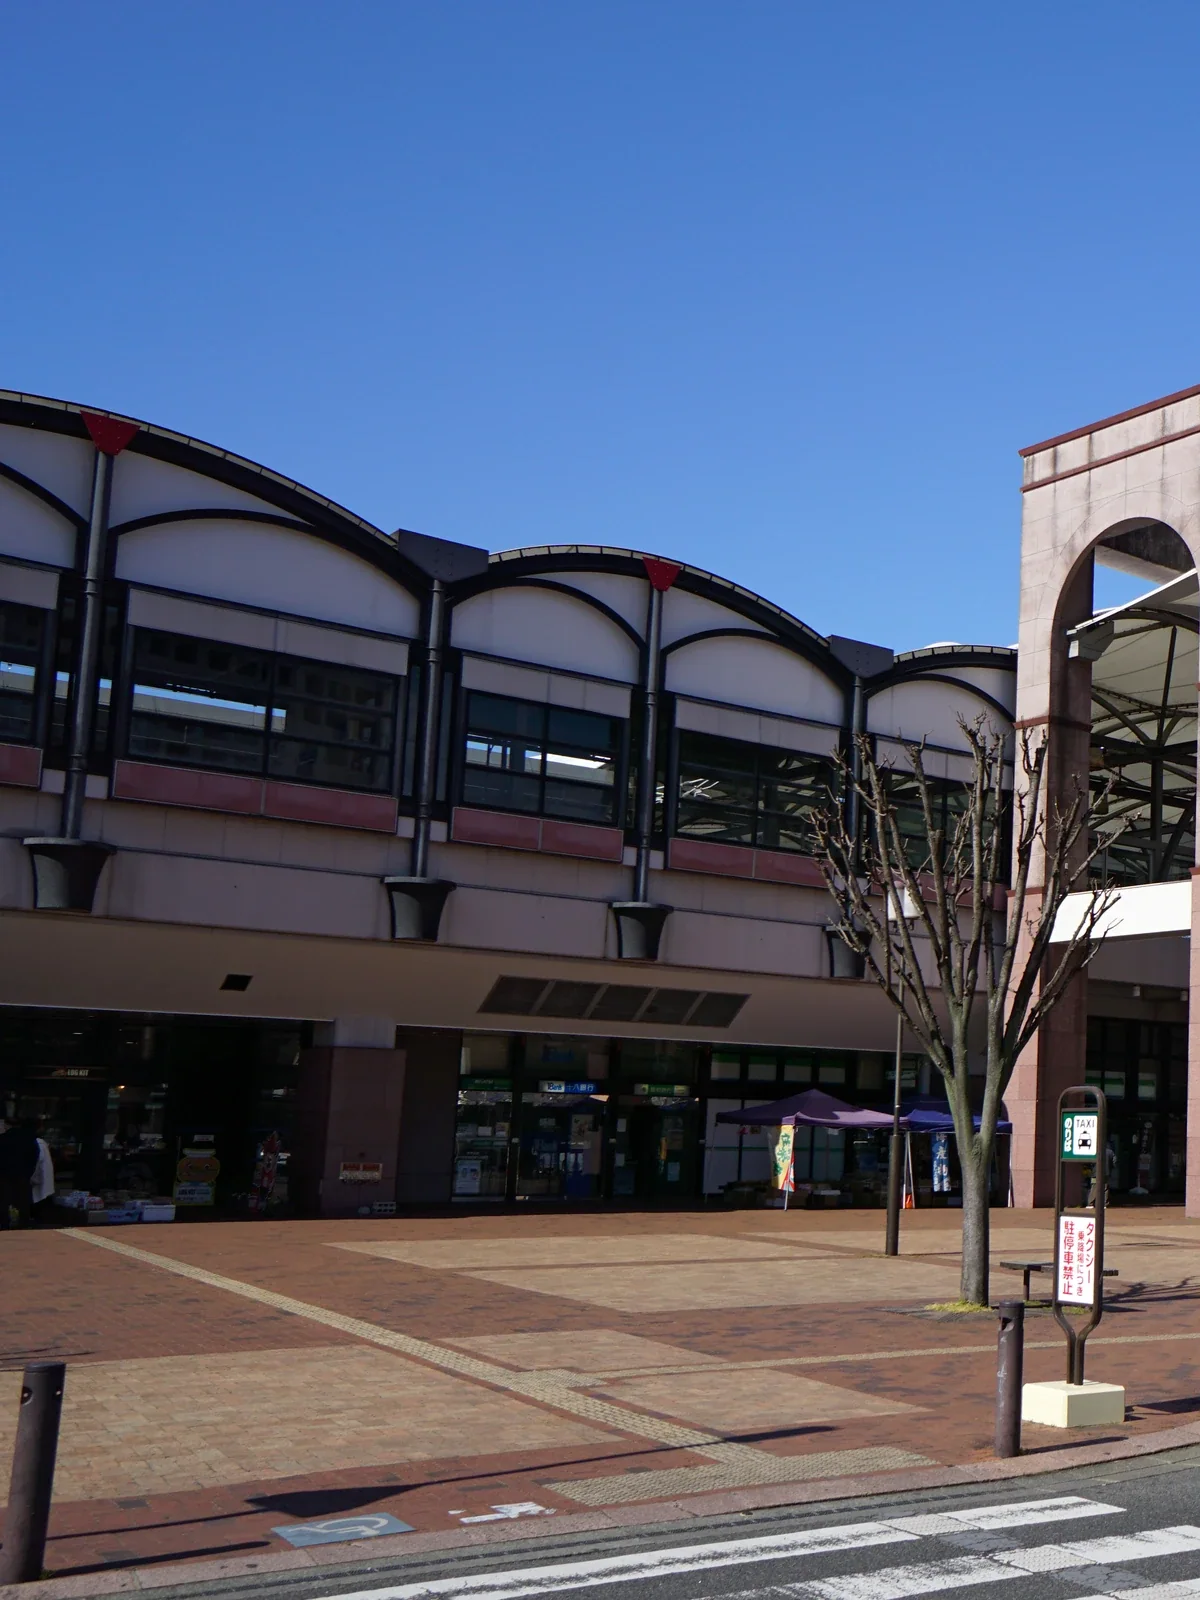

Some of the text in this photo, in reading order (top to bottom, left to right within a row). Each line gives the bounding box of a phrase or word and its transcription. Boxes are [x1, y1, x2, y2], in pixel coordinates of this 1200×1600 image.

[566, 1083, 595, 1092] 十八銀行
[1064, 1117, 1073, 1152] のりば
[1076, 1119, 1095, 1128] TAXI
[1062, 1220, 1075, 1296] 駐停車禁止
[1085, 1222, 1095, 1283] タクシー
